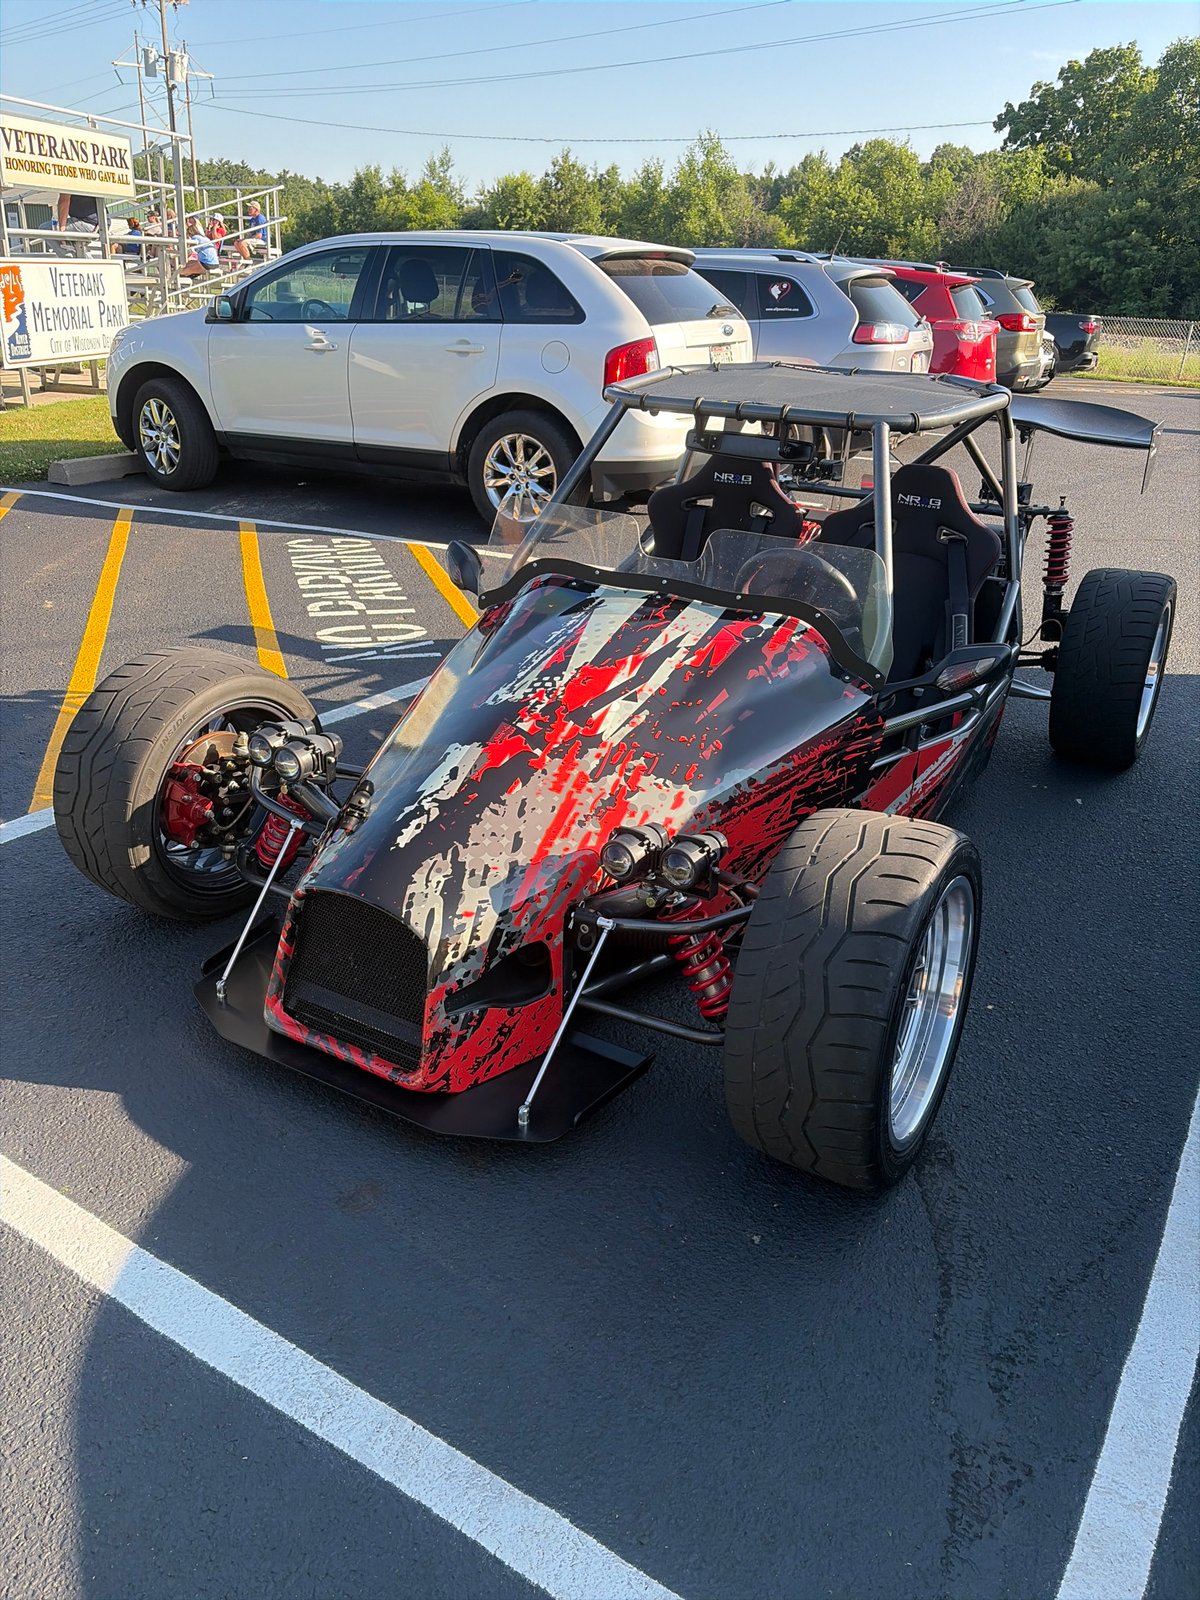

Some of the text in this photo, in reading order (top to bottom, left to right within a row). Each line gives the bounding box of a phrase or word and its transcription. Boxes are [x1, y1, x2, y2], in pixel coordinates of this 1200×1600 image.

[0, 127, 130, 170] VETERANS PARK
[4, 156, 130, 185] HONORING THOSE WHO GAVE ALL
[49, 267, 105, 298] VETERANS
[32, 300, 125, 332] MEMORIAL PARK
[160, 713, 188, 750] INSIDE
